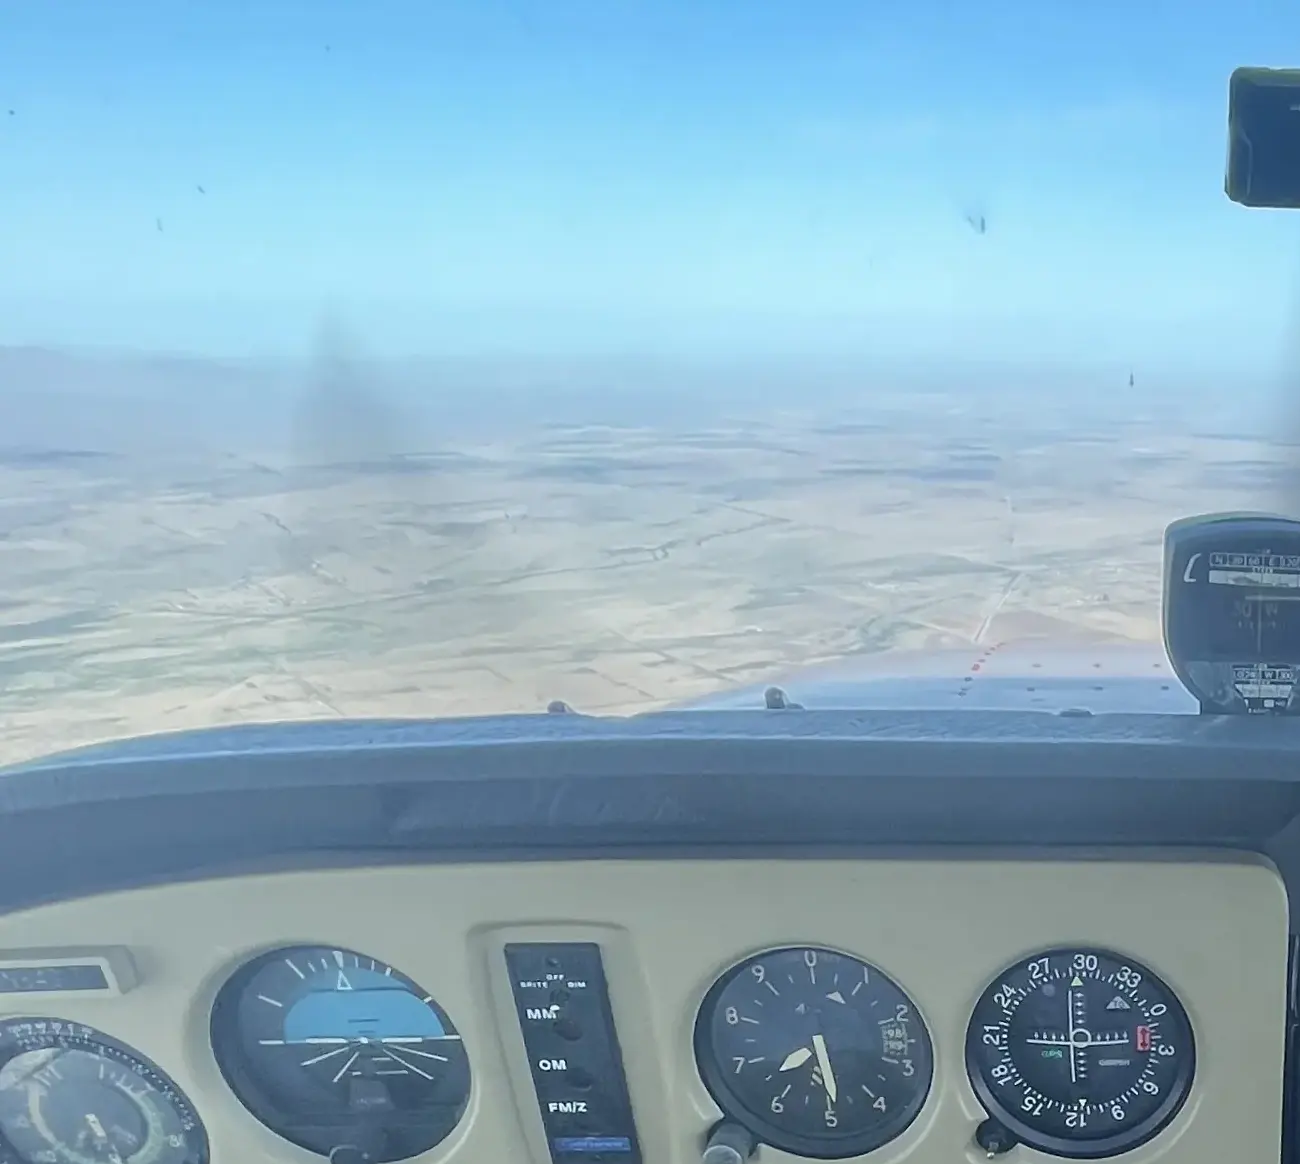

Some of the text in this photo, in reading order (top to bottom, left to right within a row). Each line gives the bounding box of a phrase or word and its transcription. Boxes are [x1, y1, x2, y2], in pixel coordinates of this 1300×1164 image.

[804, 951, 817, 967] 0
[1073, 954, 1098, 970] 30
[751, 965, 765, 983] 9
[1028, 958, 1051, 979] 27
[1116, 966, 1142, 988] 33
[993, 983, 1017, 1009] 24
[526, 1008, 557, 1019] MM
[725, 1006, 739, 1024] 8
[896, 1004, 908, 1022] 2
[1150, 1003, 1167, 1016] 0
[983, 1024, 1000, 1046] 21
[1158, 1044, 1175, 1057] 3
[538, 1059, 567, 1070] OM
[733, 1057, 745, 1074] 7
[902, 1060, 914, 1076] 3
[991, 1064, 1012, 1086] 18
[1143, 1082, 1160, 1095] 6
[549, 1102, 587, 1113] FM/Z
[771, 1097, 784, 1113] 6
[873, 1097, 886, 1112] 4
[1021, 1096, 1044, 1116] 15
[825, 1111, 837, 1127] 5
[1065, 1112, 1087, 1127] 12
[1111, 1105, 1125, 1121] 9
